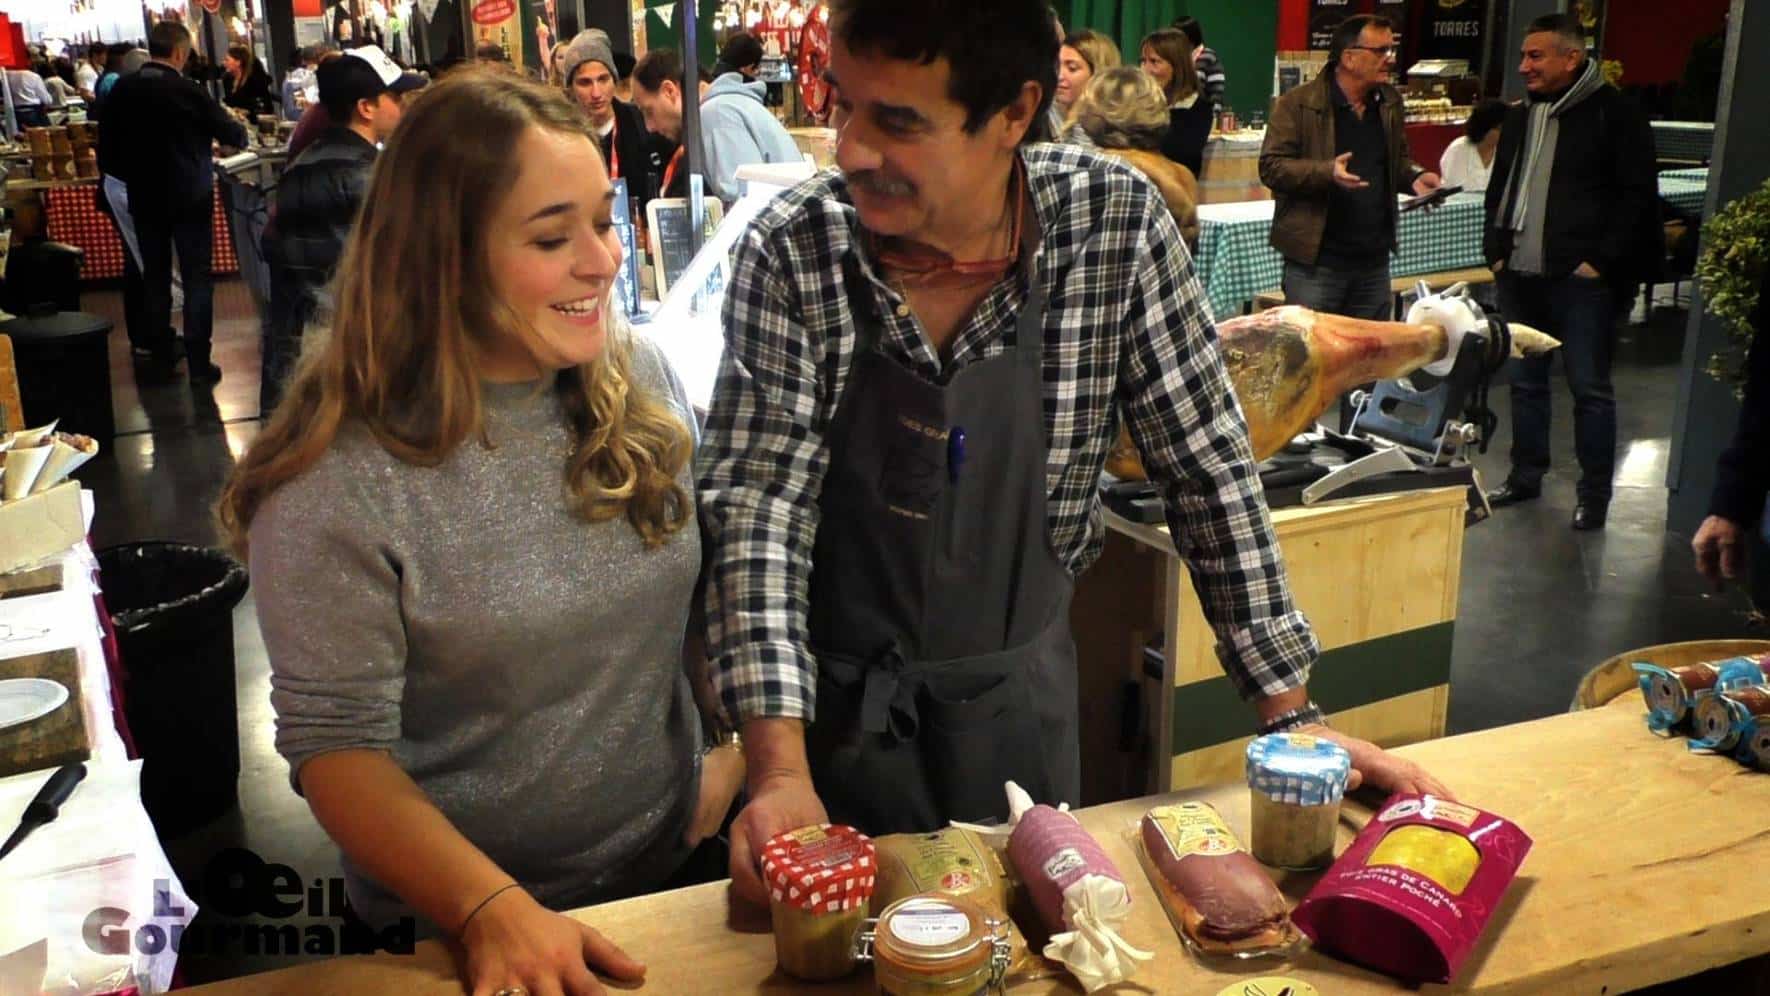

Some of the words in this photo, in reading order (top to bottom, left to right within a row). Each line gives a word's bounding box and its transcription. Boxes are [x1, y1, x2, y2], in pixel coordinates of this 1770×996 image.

[1433, 21, 1479, 37] TORRES
[1355, 874, 1398, 886] ENTIER
[1367, 867, 1398, 876] GRAS
[1401, 874, 1416, 883] DE
[1420, 881, 1462, 918] CANARD
